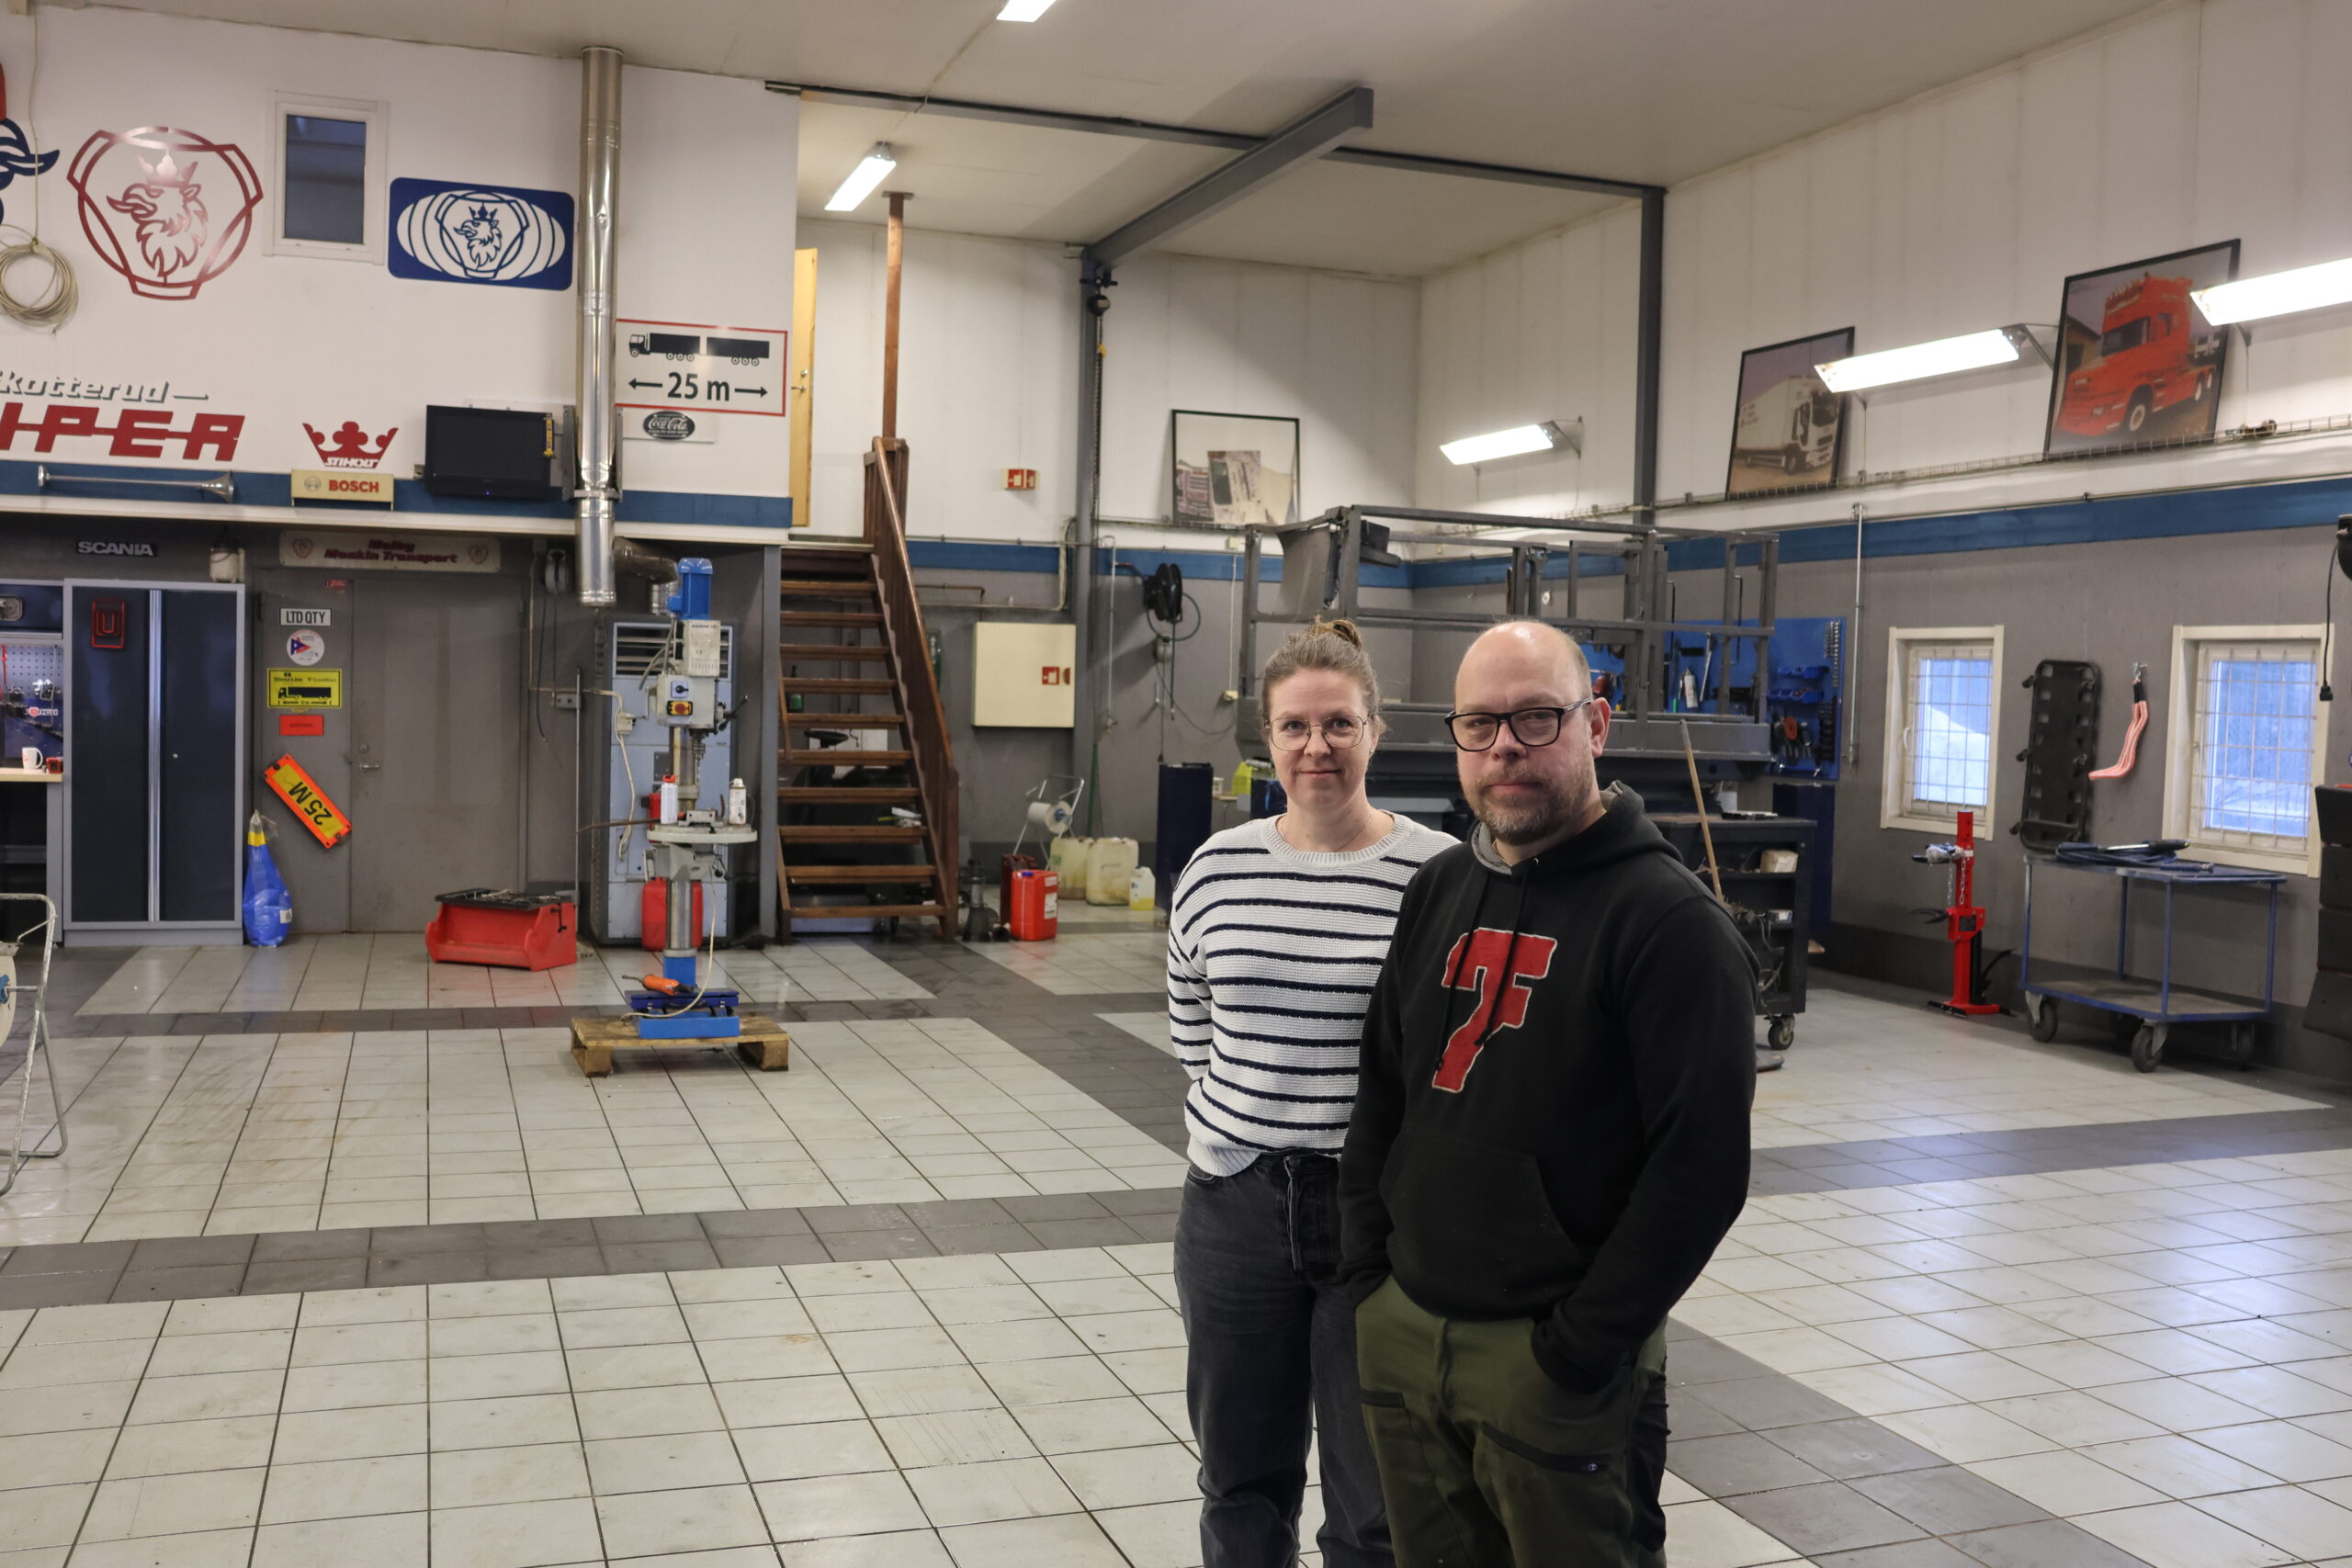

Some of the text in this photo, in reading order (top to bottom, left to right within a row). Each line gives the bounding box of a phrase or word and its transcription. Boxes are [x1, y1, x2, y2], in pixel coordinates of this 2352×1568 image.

[0, 370, 170, 403] kotterud
[667, 371, 730, 401] 25 m
[328, 479, 379, 493] BOSCH
[77, 541, 153, 556] SCANIA
[287, 611, 325, 625] LTD QTY
